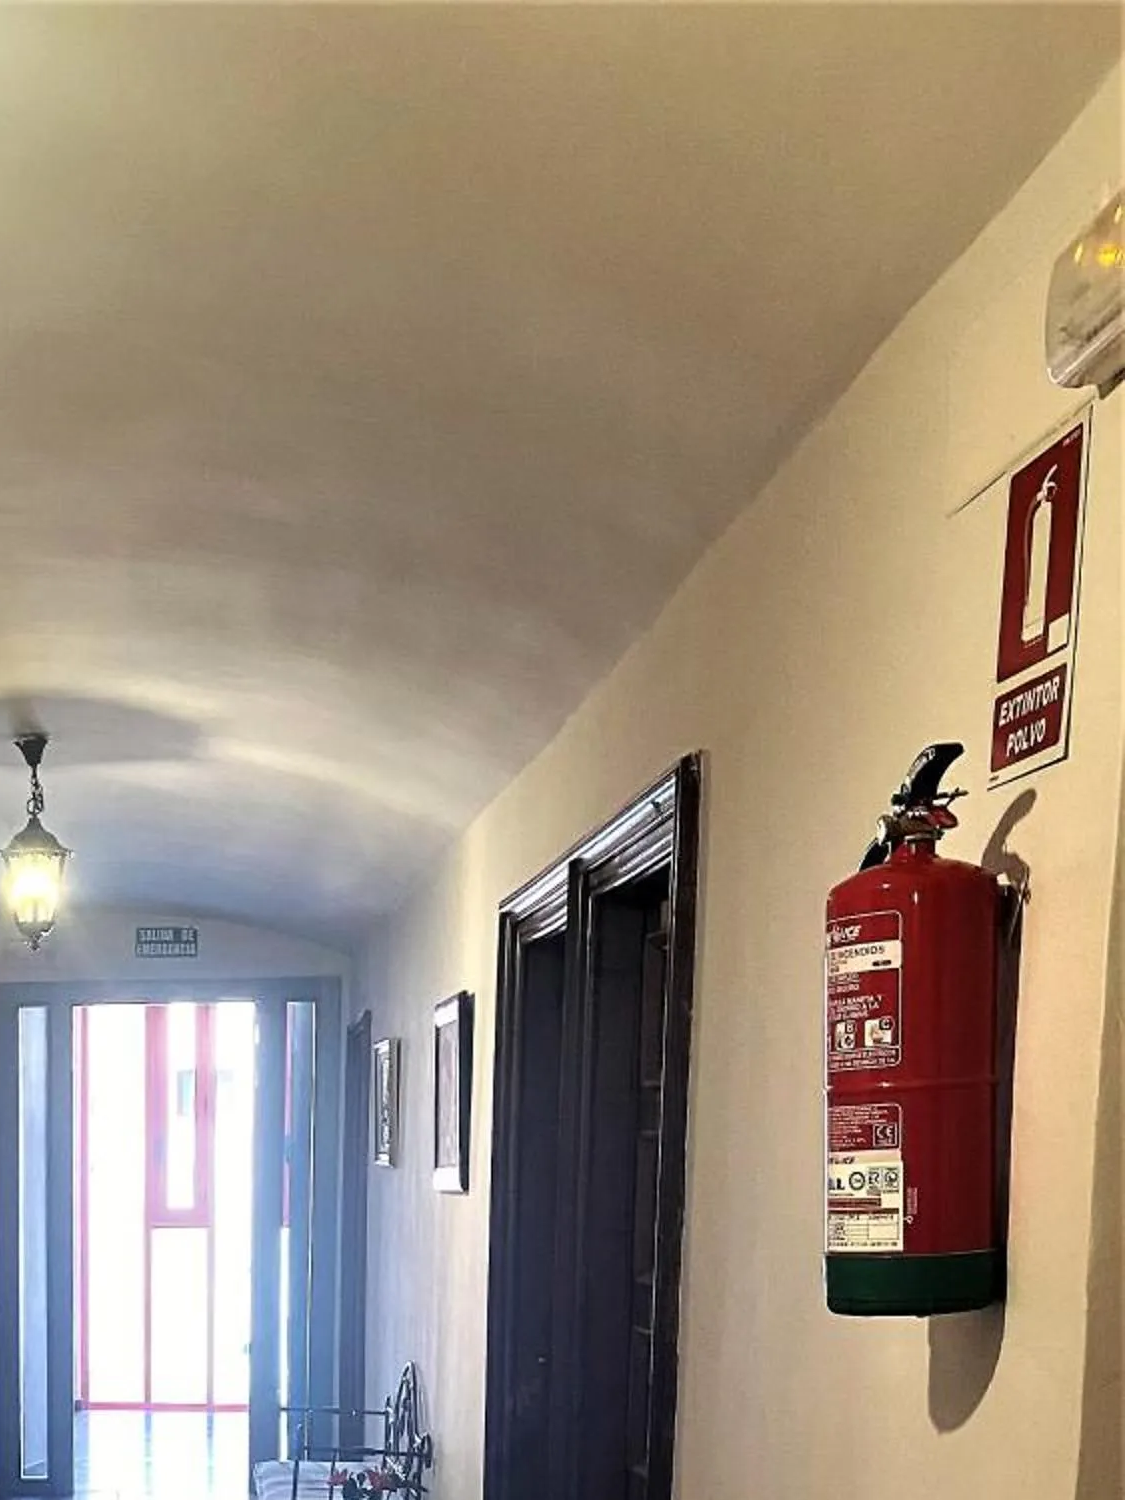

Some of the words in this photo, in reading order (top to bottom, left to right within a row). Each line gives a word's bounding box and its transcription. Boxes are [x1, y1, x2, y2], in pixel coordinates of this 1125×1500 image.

[998, 675, 1060, 727] EXTINTOR
[1006, 717, 1046, 758] POLVO
[138, 929, 174, 941] SALIDA
[181, 929, 196, 941] DE
[137, 943, 196, 955] EMERGENCIA
[876, 1125, 894, 1139] CE
